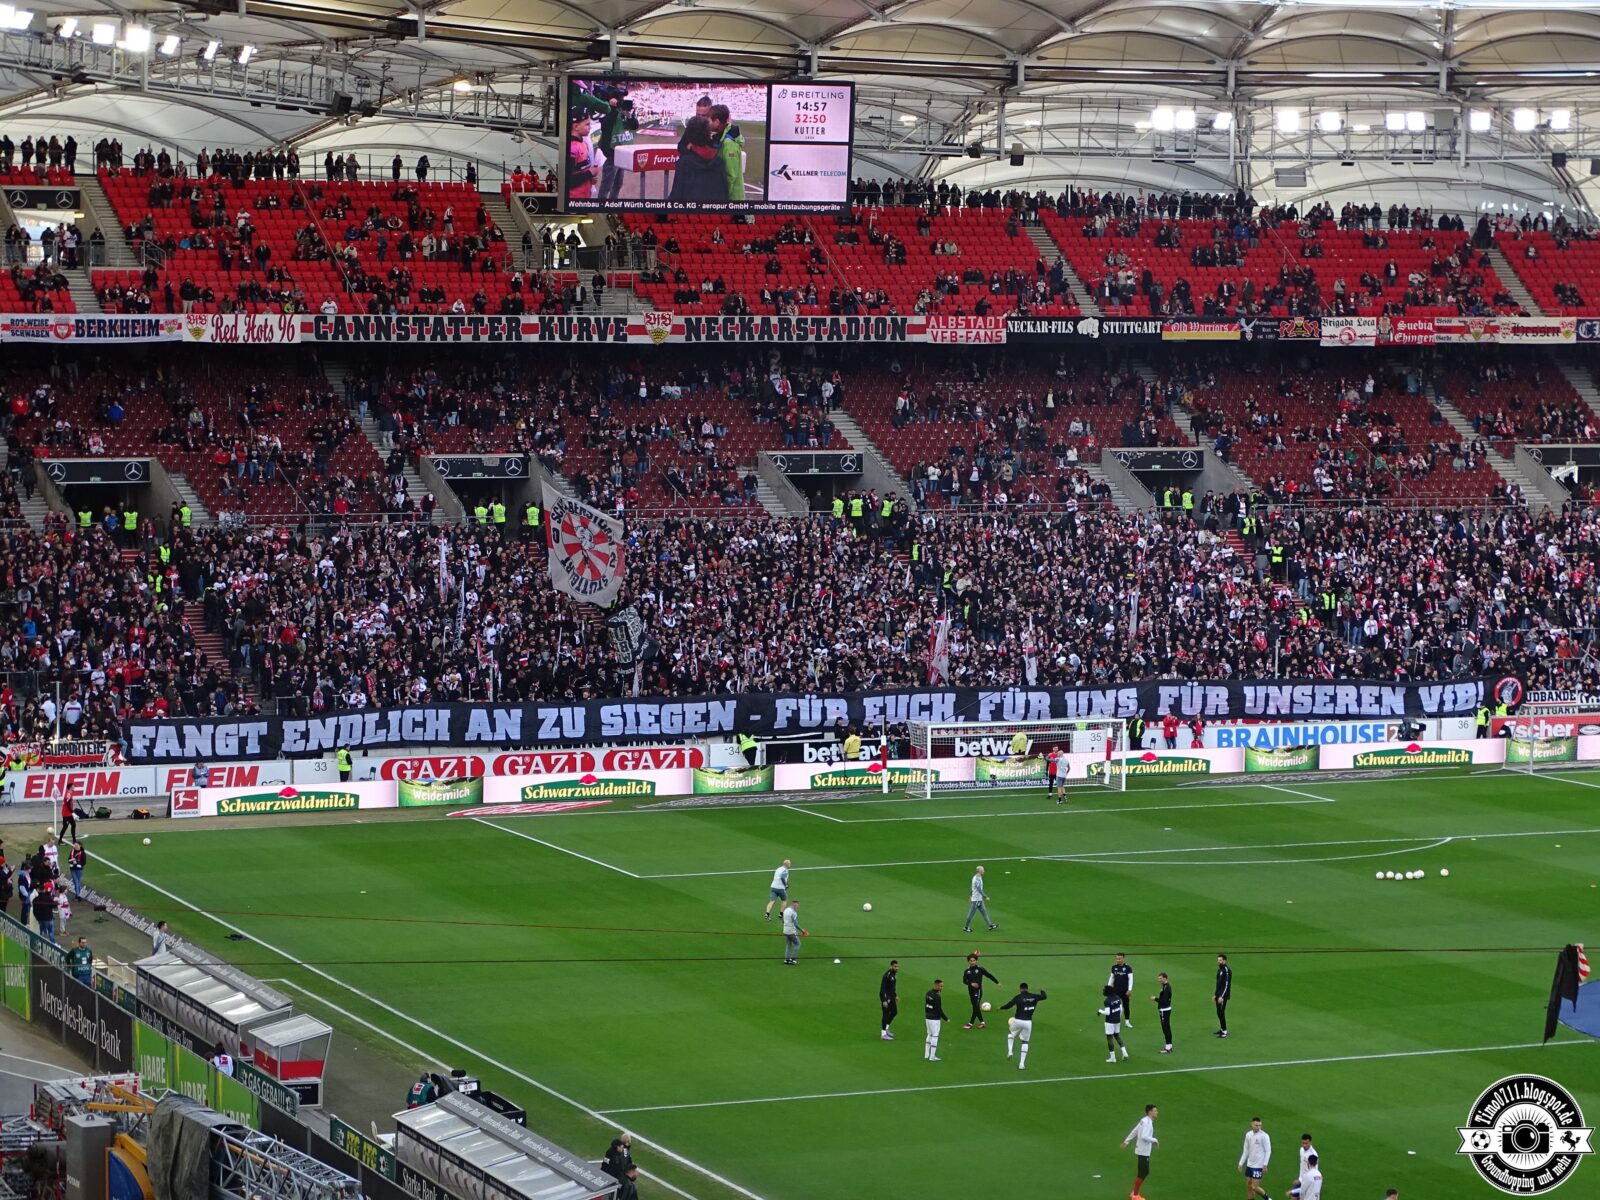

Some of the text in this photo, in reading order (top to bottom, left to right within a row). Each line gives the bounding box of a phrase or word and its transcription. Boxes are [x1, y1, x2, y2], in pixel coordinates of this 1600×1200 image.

[791, 91, 844, 99] BREITLING
[796, 102, 827, 112] 14:57
[795, 114, 827, 123] 32:50
[794, 127, 826, 135] KUTTER
[777, 203, 841, 211] Entstaubungsgeräte
[75, 319, 160, 338] BERKHEIM
[211, 314, 296, 343] Red Hots 96
[314, 316, 628, 342] CANNSTATTER KURVE
[684, 317, 909, 342] NECKARSTADION
[929, 316, 1005, 329] ALBSTADT
[1006, 320, 1163, 334] NECKAR-FILS STUTTGART
[931, 329, 1004, 342] VFB-FANS
[130, 722, 267, 757] FANGT
[281, 708, 451, 752] ENDLICH
[465, 708, 522, 741] AN
[538, 706, 586, 740] ZU
[601, 700, 737, 738] SIEGEN
[774, 694, 849, 729] FÜR
[863, 692, 966, 724] EUCH,
[979, 687, 1051, 721] FÜR
[1064, 687, 1146, 718] UNS,
[1157, 681, 1230, 715] FÜR
[1243, 684, 1406, 715] UNSEREN
[1418, 681, 1485, 713] VfB!
[1457, 720, 1469, 729] 36
[1090, 732, 1102, 742] 35
[1217, 723, 1386, 749] BRAINHOUSE
[503, 753, 584, 776] GAZI
[613, 749, 693, 771] GAZI
[1256, 754, 1308, 767] Weidemilch
[1356, 750, 1469, 766] Schwarzwaldmilch
[314, 761, 328, 772] 33
[391, 757, 475, 781] GAZI
[706, 776, 762, 789] Weidemilch
[412, 787, 470, 801] Weidemilch
[525, 781, 652, 800] Schwarzwaldmilch
[220, 793, 355, 813] Schwarzwaldmilch
[40, 979, 97, 1044] Mercedes-Benz
[100, 1018, 122, 1063] Bank
[140, 1054, 166, 1084] LIBARE
